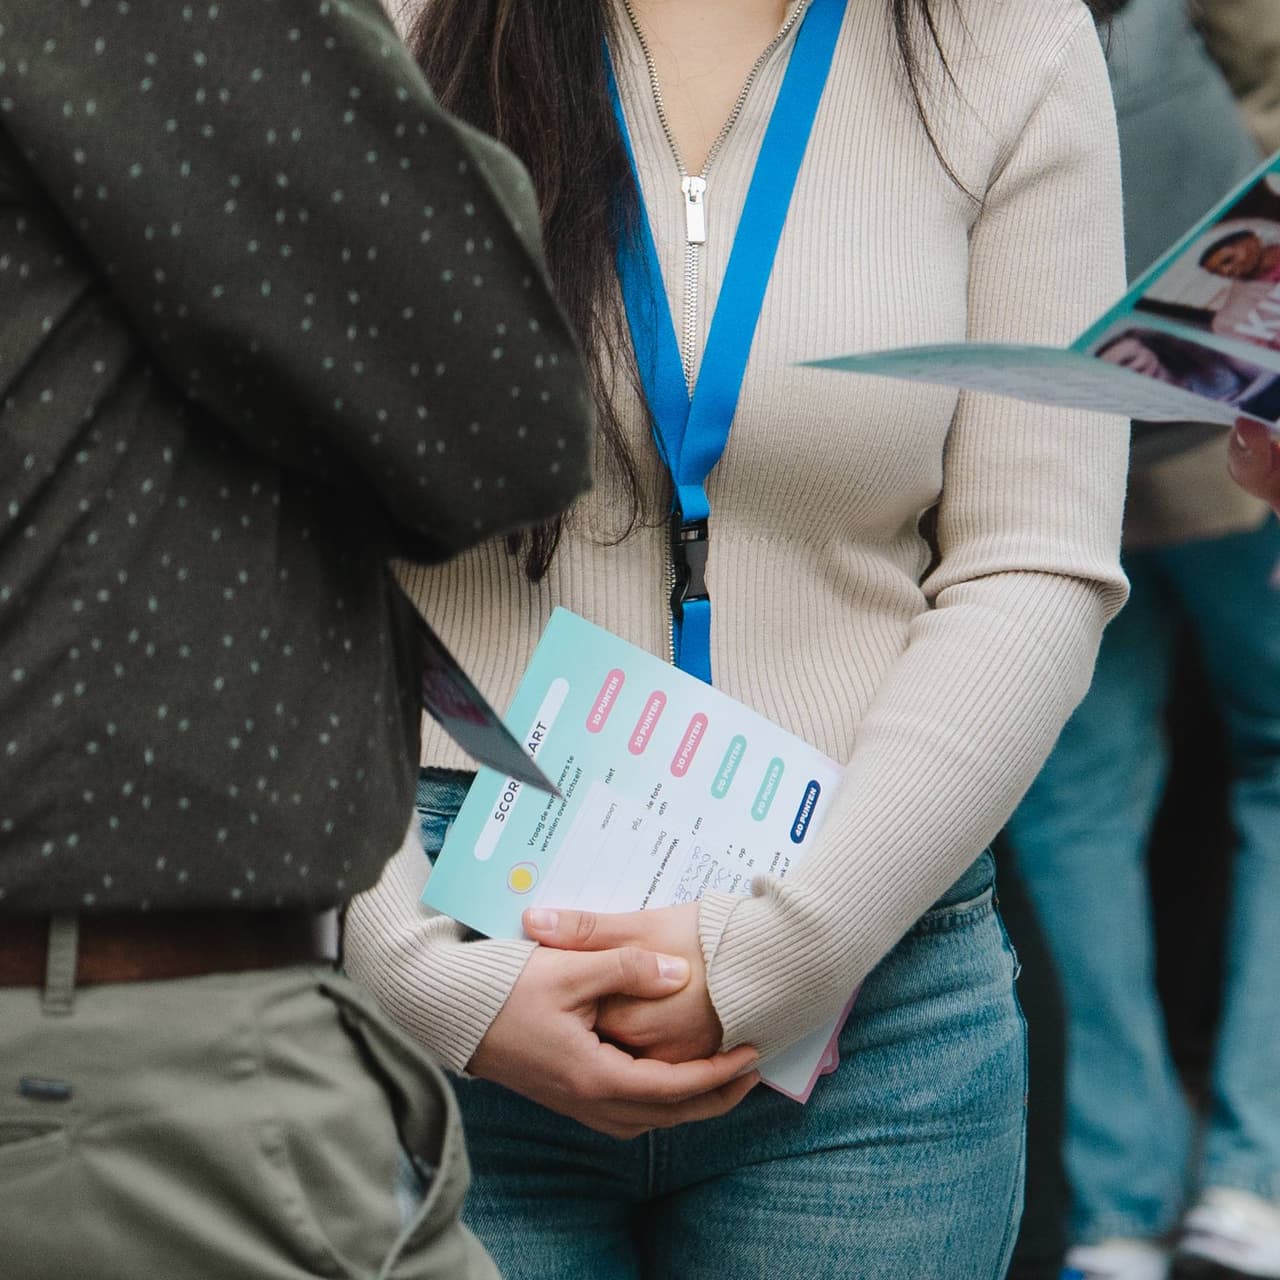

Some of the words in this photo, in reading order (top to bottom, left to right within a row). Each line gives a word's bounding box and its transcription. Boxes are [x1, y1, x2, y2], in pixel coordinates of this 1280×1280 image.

[597, 676, 620, 714] PUNTEN
[640, 698, 662, 736] PUNTEN
[681, 720, 703, 759] PUNTEN
[604, 767, 616, 784] niet
[721, 742, 742, 780] PUNTEN
[540, 817, 560, 852] vertellen
[557, 798, 569, 817] over
[566, 767, 583, 798] zichzelf
[650, 782, 662, 800] foto
[799, 786, 817, 825] PUNTEN
[527, 821, 546, 847] Vraag
